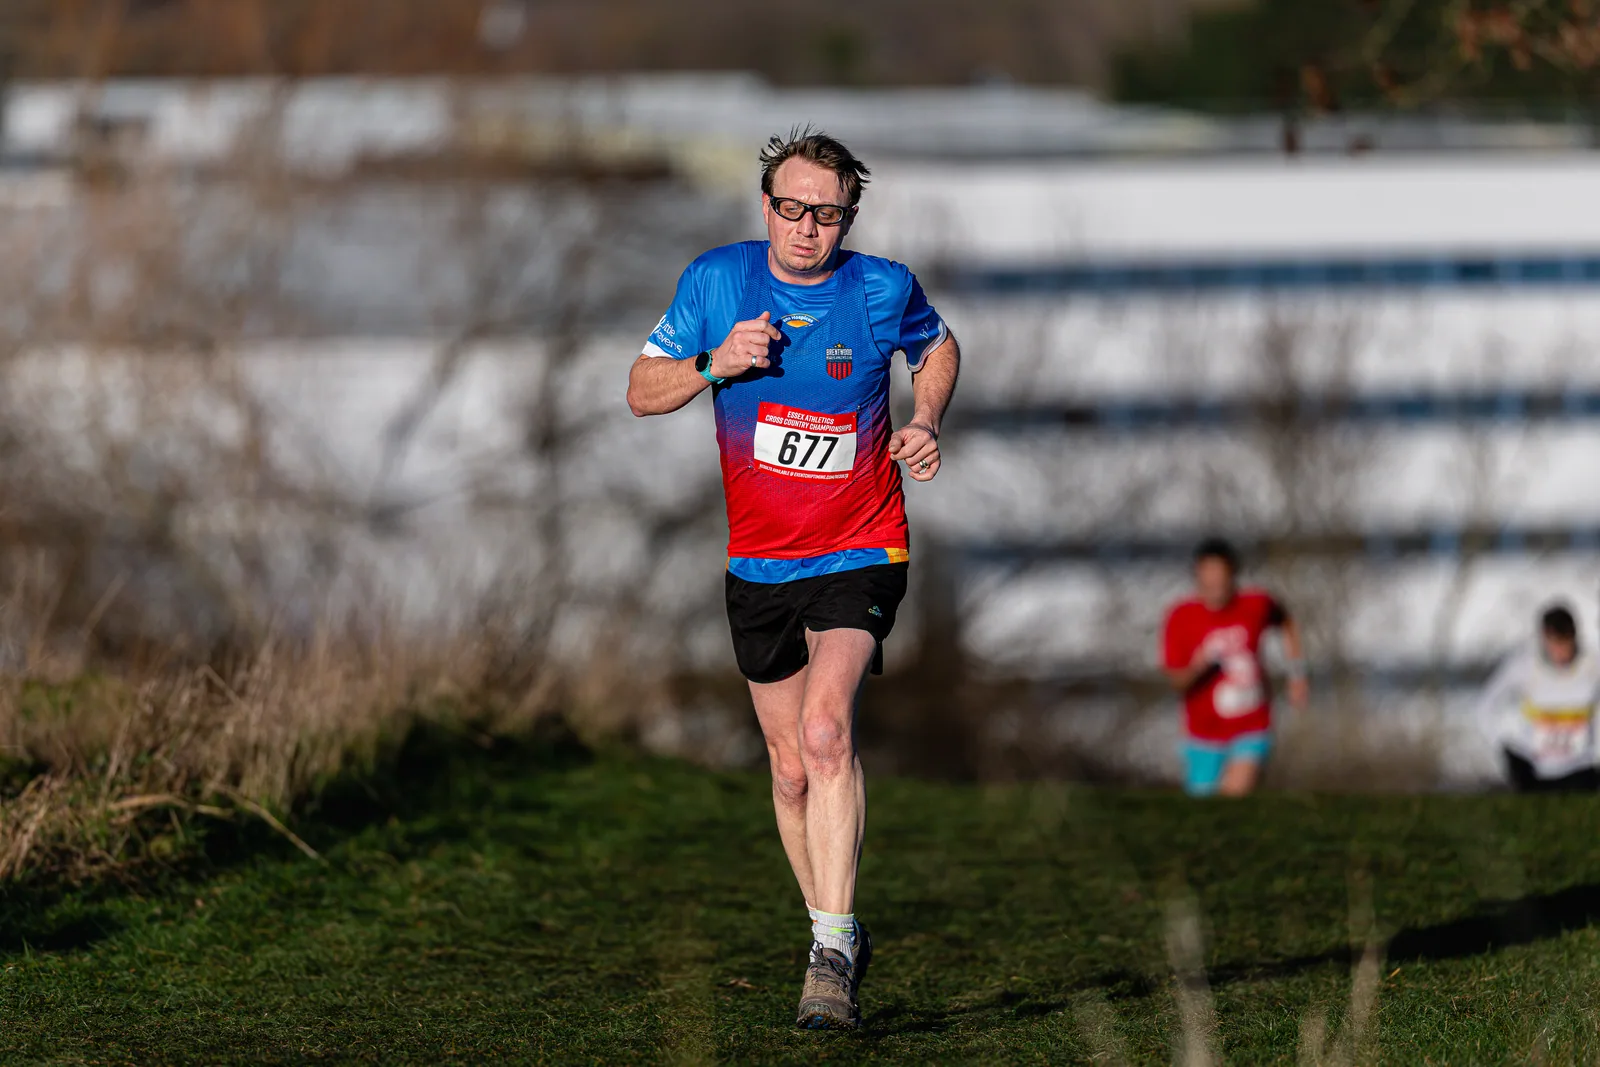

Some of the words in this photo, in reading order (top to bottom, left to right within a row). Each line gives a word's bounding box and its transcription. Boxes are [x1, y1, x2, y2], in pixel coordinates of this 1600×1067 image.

[765, 414, 783, 424] CROSS
[783, 418, 810, 428] COUNTRY
[809, 423, 852, 432] CHAMPIONSHIPS
[787, 411, 805, 420] ESSEX
[805, 414, 835, 425] ATHLETICS
[777, 431, 839, 469] 677
